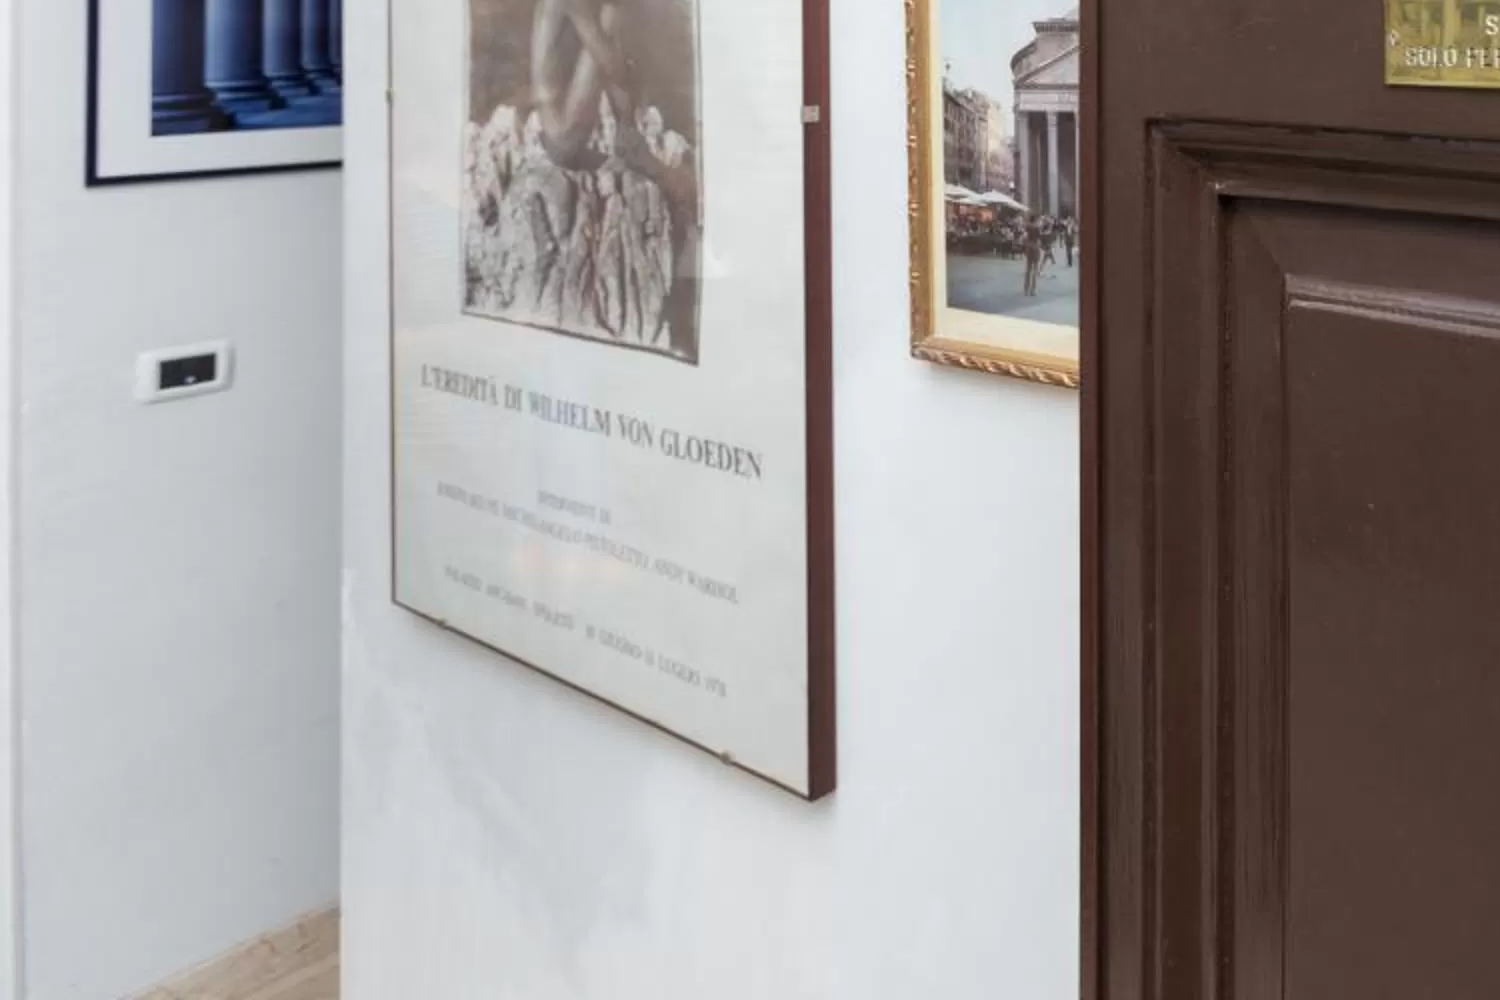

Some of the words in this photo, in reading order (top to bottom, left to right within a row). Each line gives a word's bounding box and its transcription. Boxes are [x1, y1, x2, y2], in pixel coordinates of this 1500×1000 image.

[1405, 47, 1457, 68] SOLO
[504, 384, 522, 411] DI
[527, 391, 610, 436] WILHELM
[617, 414, 653, 448] VON
[660, 429, 762, 479] GLOEDEN
